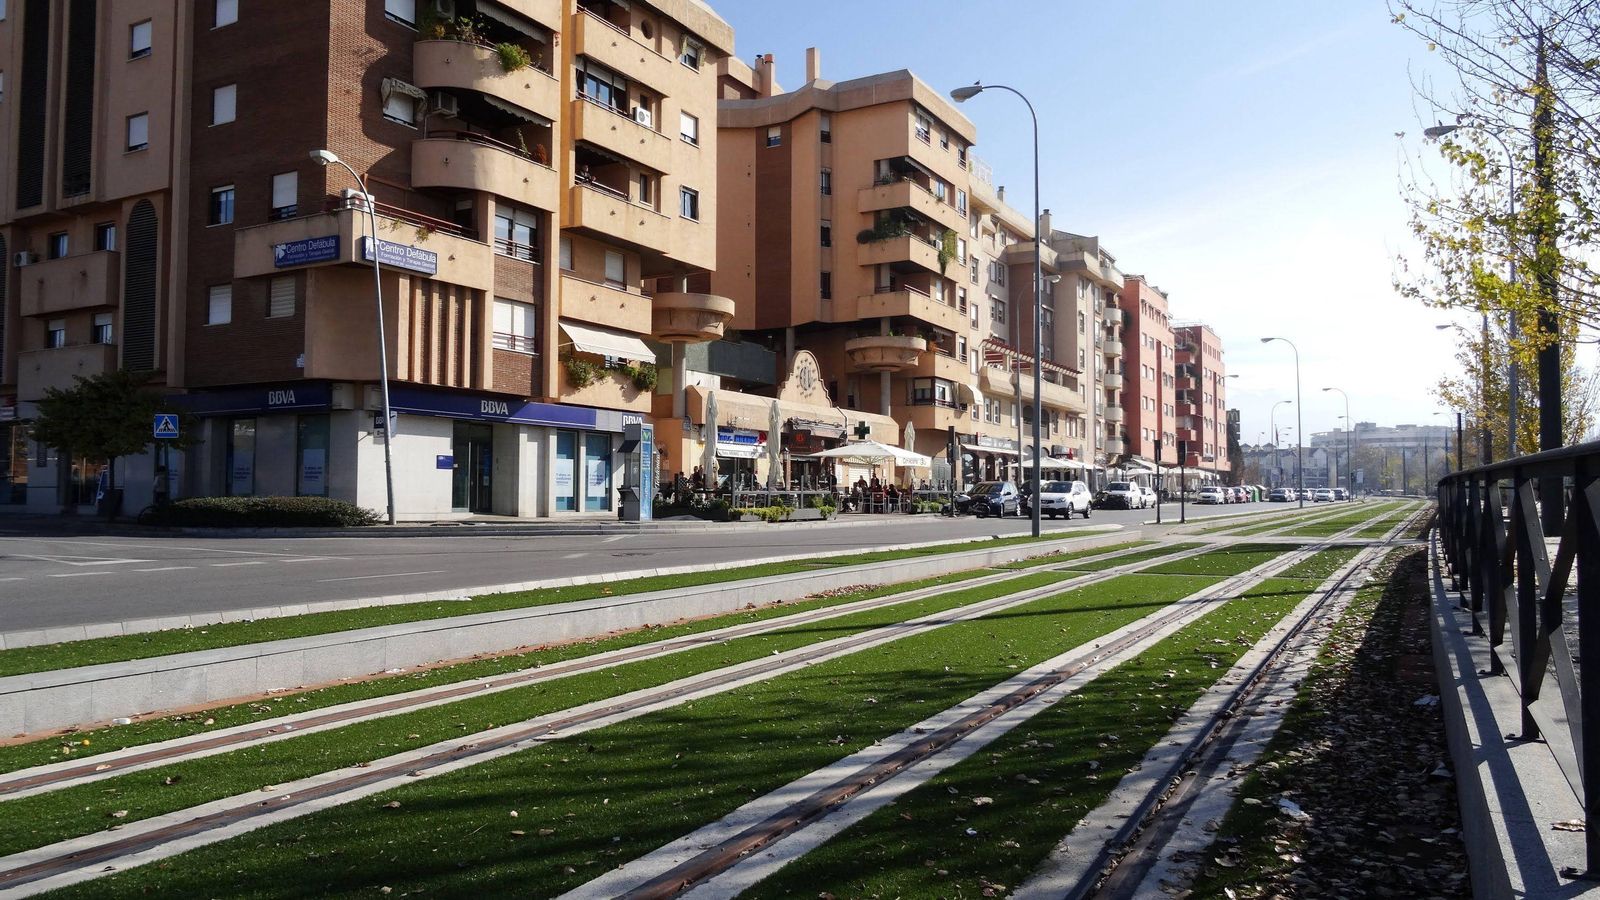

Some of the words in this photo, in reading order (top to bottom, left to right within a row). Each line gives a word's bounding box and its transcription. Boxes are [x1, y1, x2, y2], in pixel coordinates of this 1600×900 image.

[286, 243, 307, 254] Centro
[380, 241, 404, 256] Centro
[406, 246, 436, 263] Defábula
[268, 389, 296, 405] BBVA
[481, 400, 509, 415] BBVA
